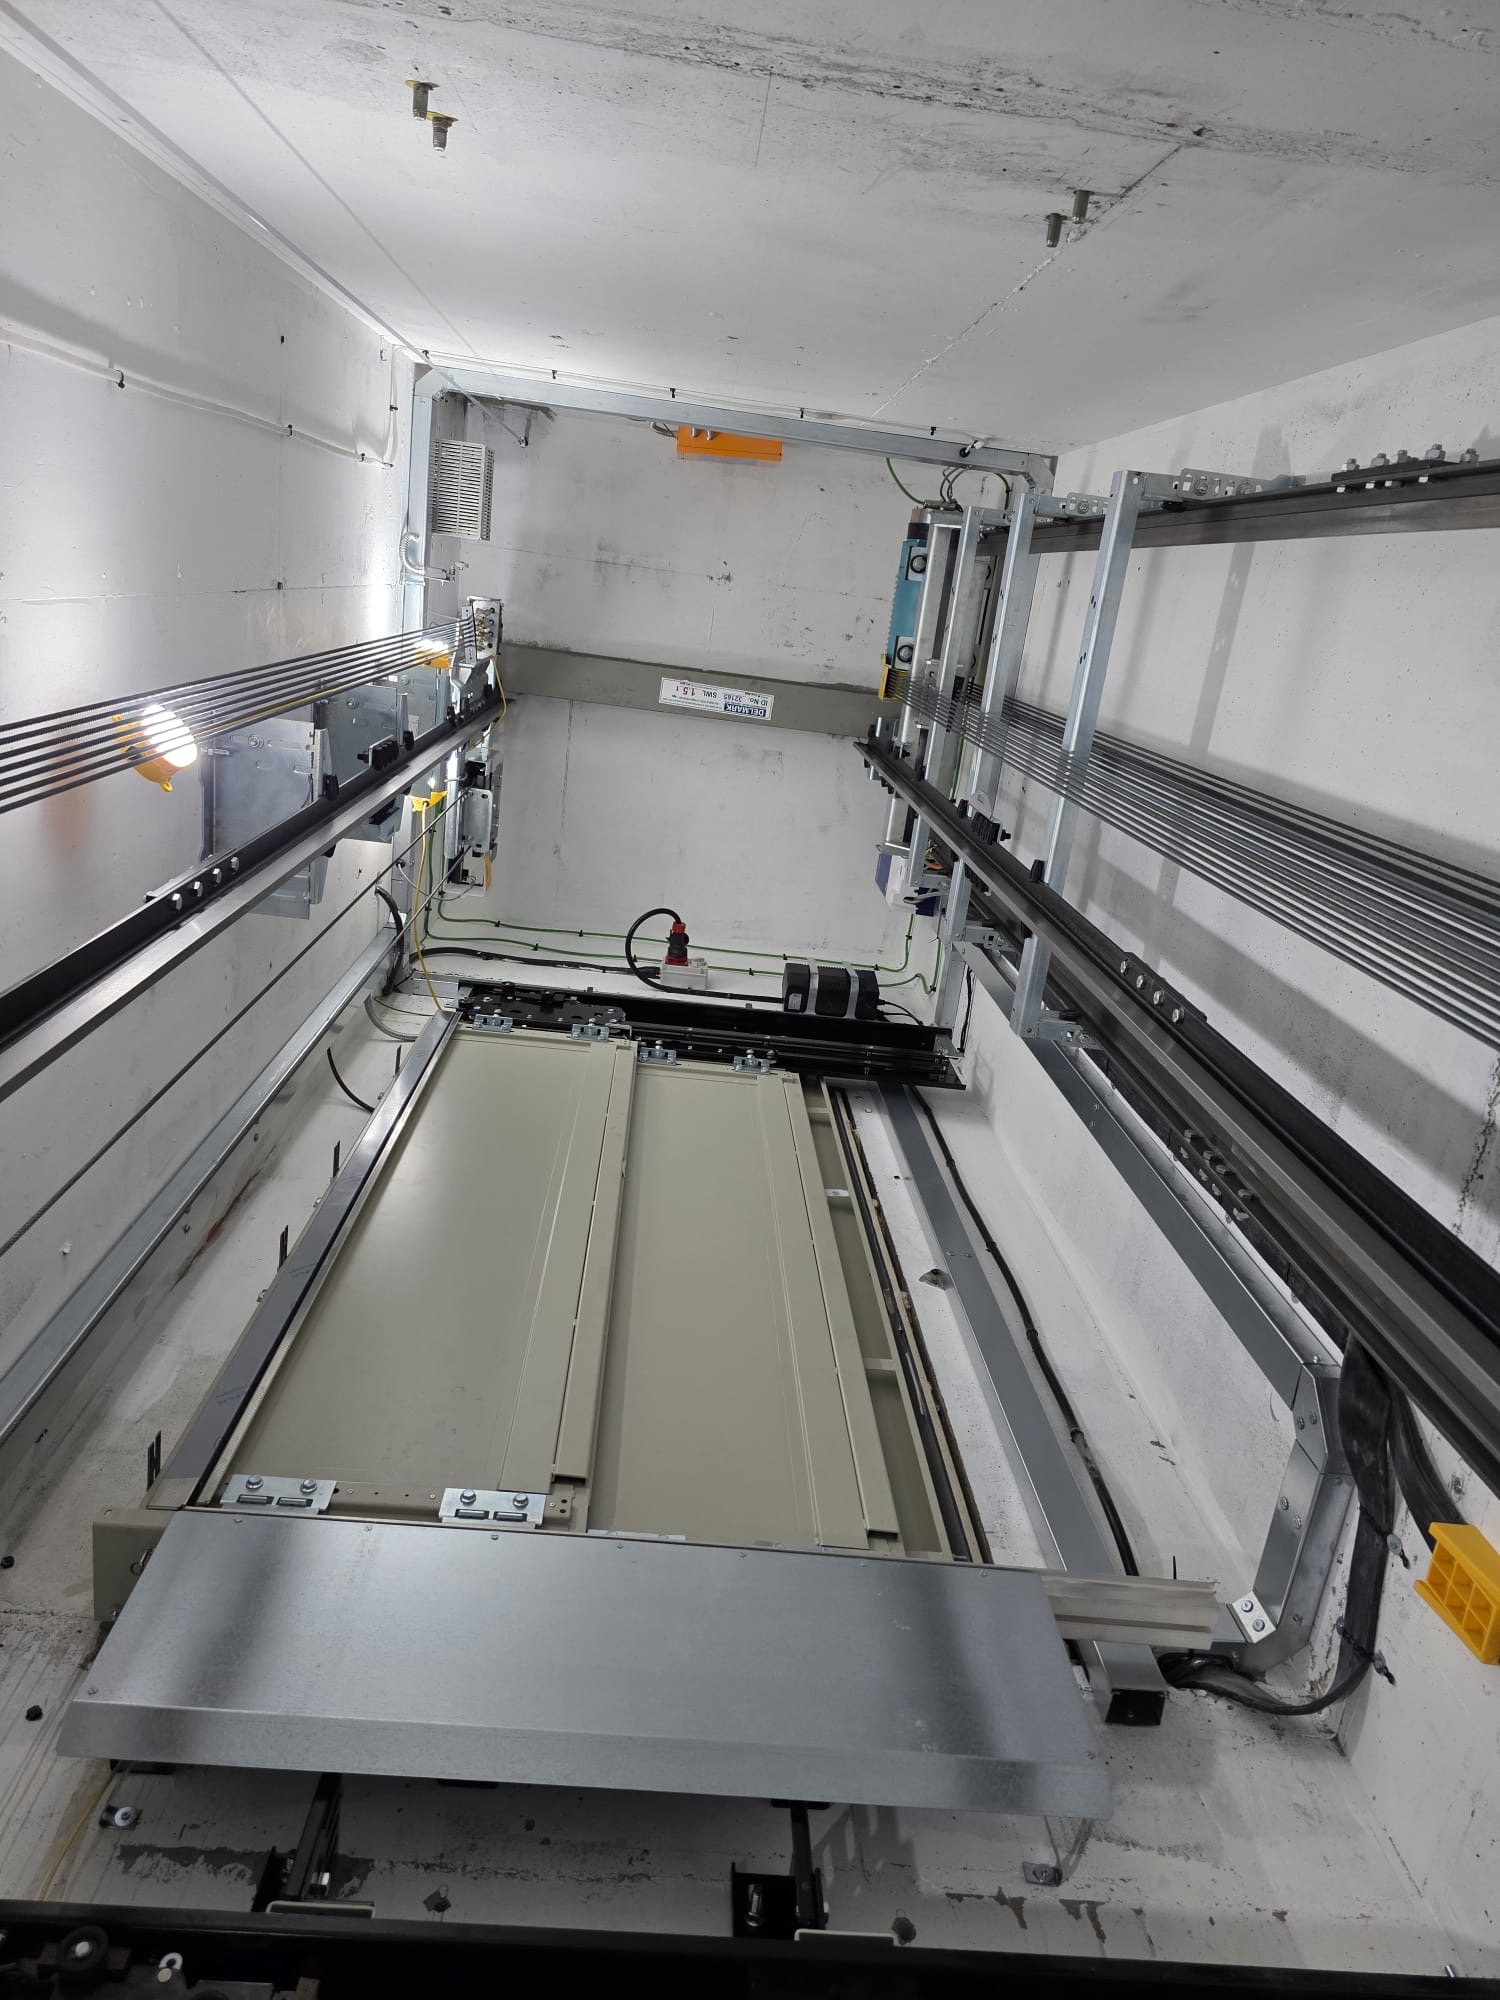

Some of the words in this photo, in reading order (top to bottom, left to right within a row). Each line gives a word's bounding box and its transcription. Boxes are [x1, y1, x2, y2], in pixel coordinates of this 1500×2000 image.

[683, 687, 696, 696] 1.5
[703, 690, 717, 699] SWL
[761, 698, 768, 707] ID
[726, 703, 765, 716] DELMARK
